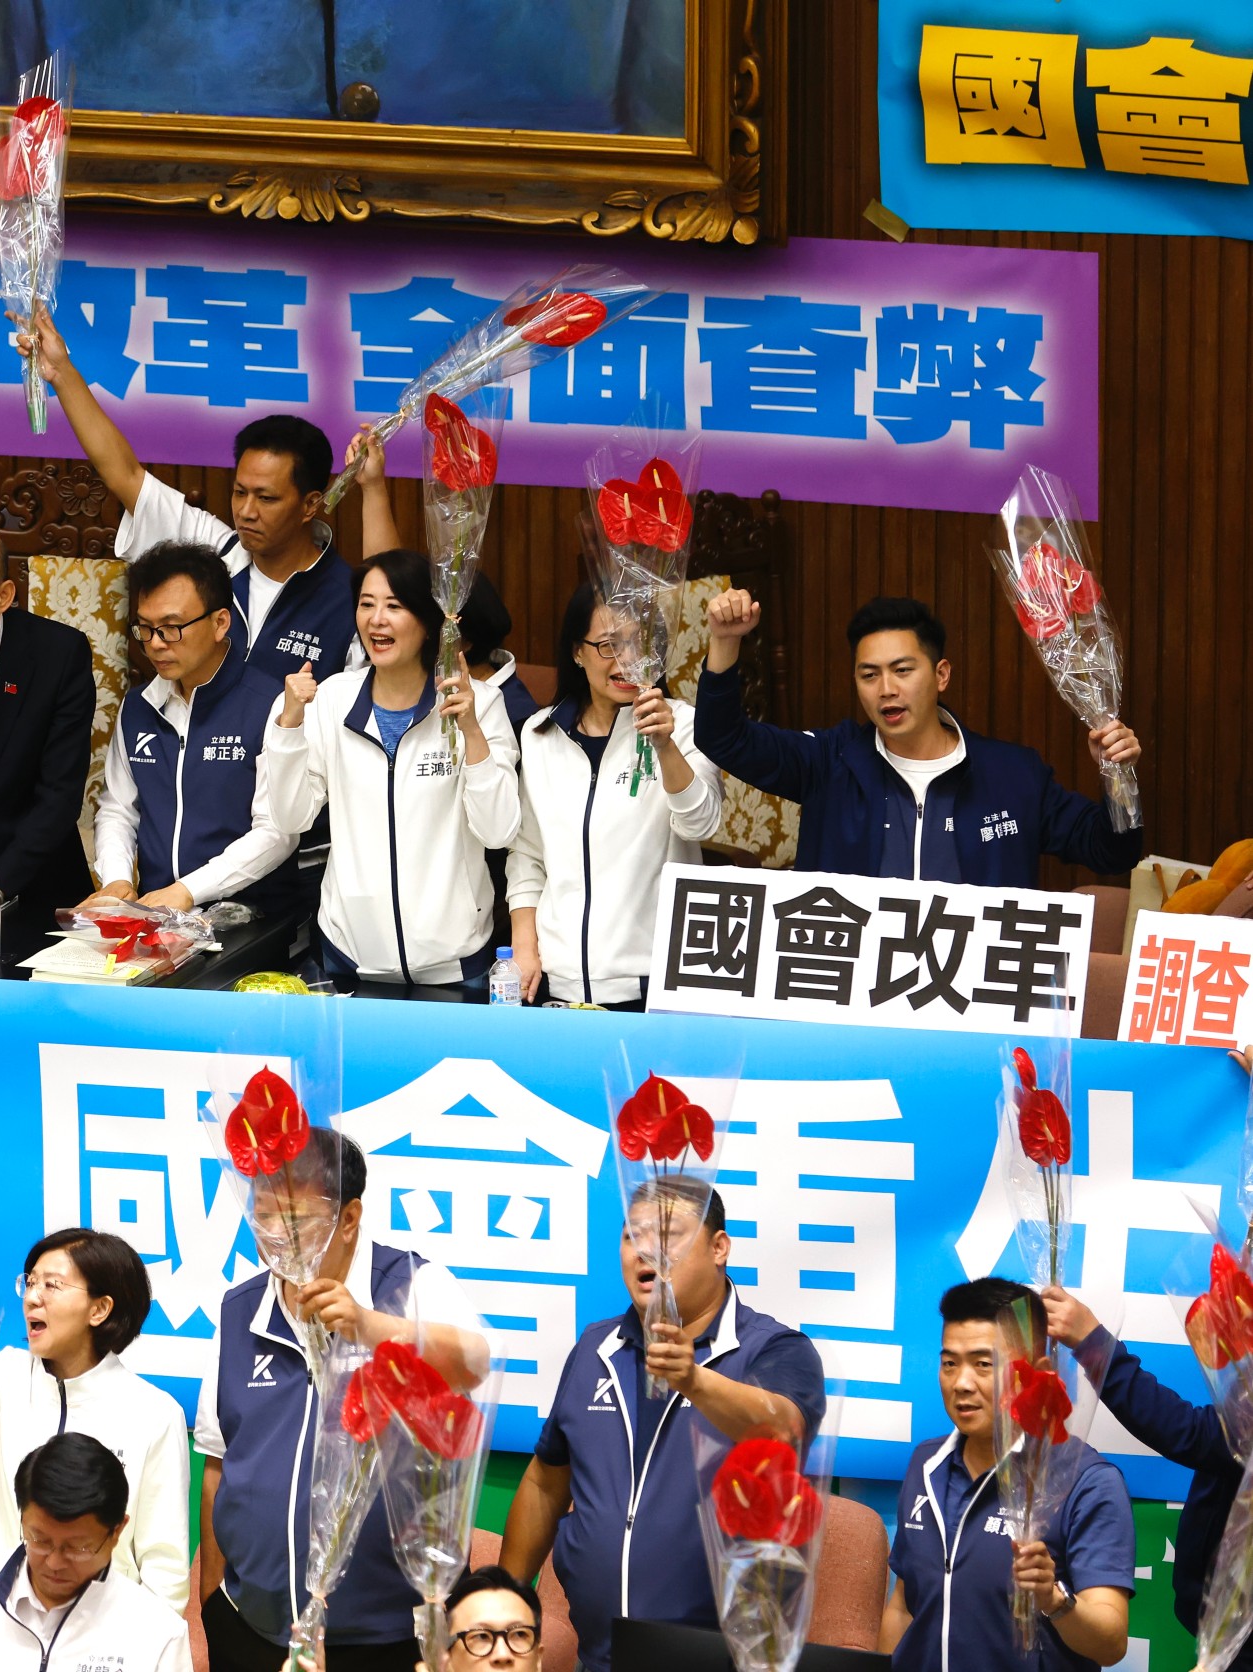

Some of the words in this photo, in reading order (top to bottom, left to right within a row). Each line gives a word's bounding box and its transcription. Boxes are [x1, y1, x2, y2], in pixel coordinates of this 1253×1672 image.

[919, 24, 1253, 185] 國會
[348, 276, 1046, 451] 全面查弊
[275, 637, 323, 662] 邱鎮軍
[288, 629, 321, 646] 立法委員
[210, 735, 242, 745] 立法委員
[982, 810, 1010, 824] 立法員
[664, 877, 1085, 1023] 國會改革
[1128, 934, 1252, 1050] 調查
